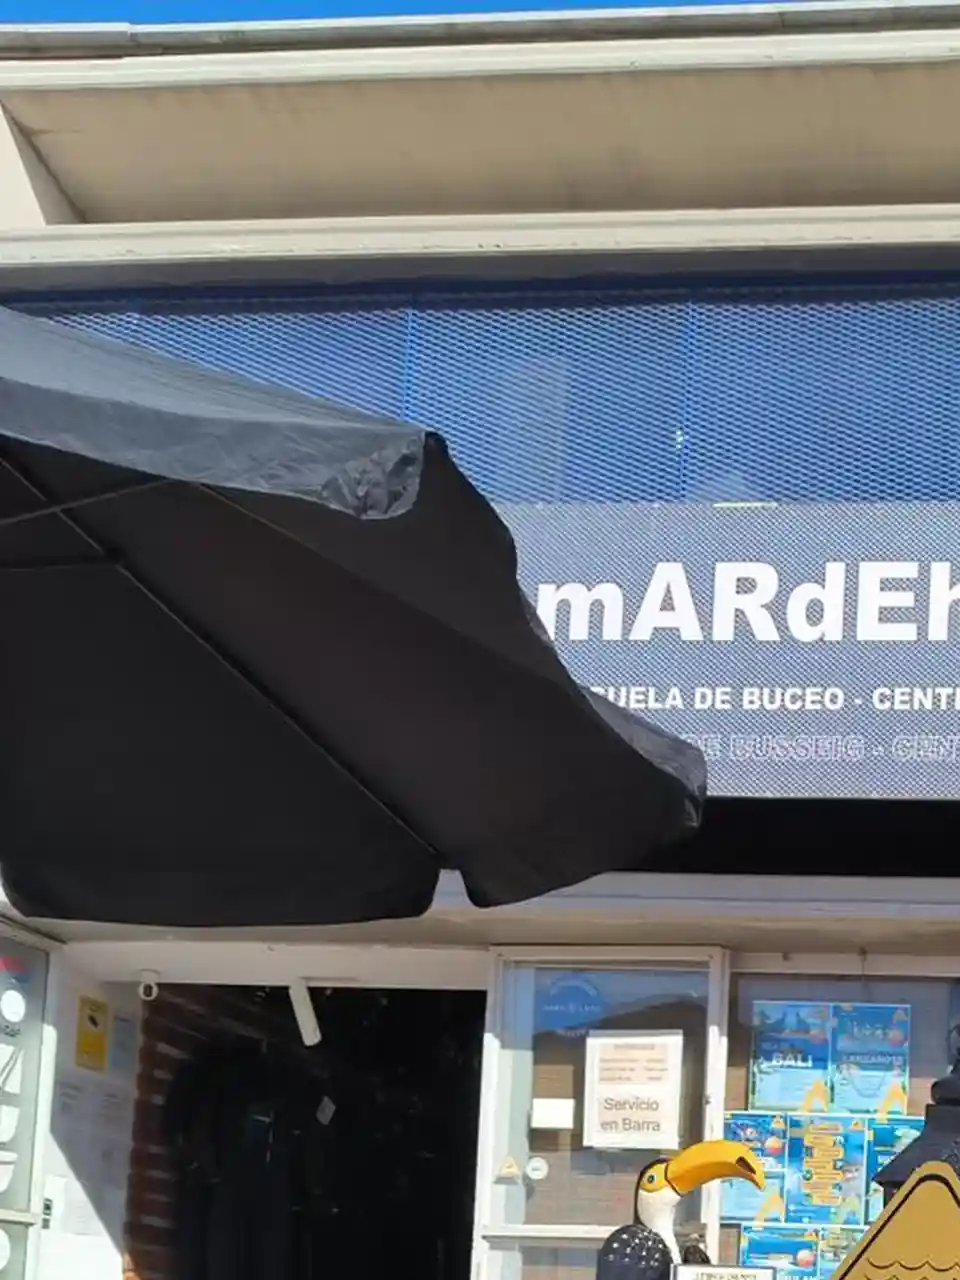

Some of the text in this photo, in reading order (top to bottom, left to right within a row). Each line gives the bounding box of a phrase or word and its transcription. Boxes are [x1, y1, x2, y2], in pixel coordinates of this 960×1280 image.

[590, 687, 685, 710] UELA
[695, 687, 732, 709] DE
[743, 687, 844, 710] BUCEO
[771, 1052, 813, 1068] BALI
[603, 1097, 660, 1111] Servicio
[600, 1117, 661, 1132] en Barra
